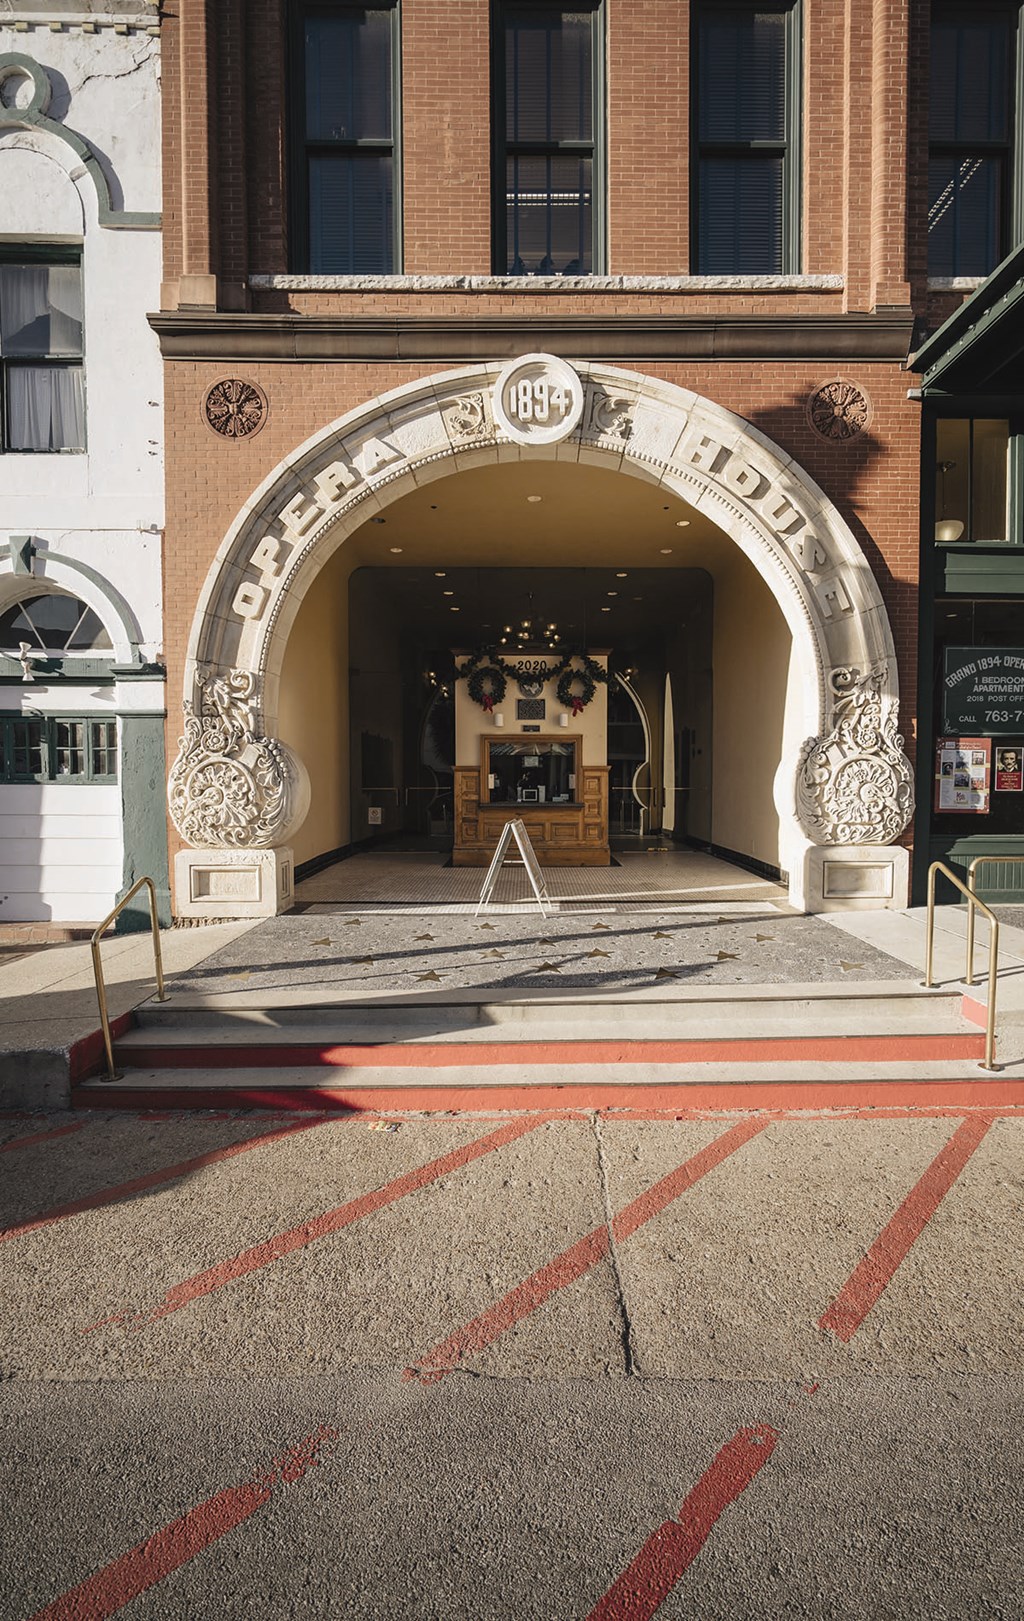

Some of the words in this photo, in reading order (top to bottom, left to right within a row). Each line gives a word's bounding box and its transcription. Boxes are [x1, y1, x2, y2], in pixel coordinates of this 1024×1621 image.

[510, 379, 569, 422] 1894
[232, 437, 402, 621] OPERA
[679, 427, 855, 618] HOUSE
[517, 660, 547, 671] 2020
[945, 662, 977, 688] GRAND
[977, 655, 1002, 671] 1894
[974, 676, 979, 684] 1
[958, 715, 977, 723] CALL
[985, 710, 1024, 723] 763-7
